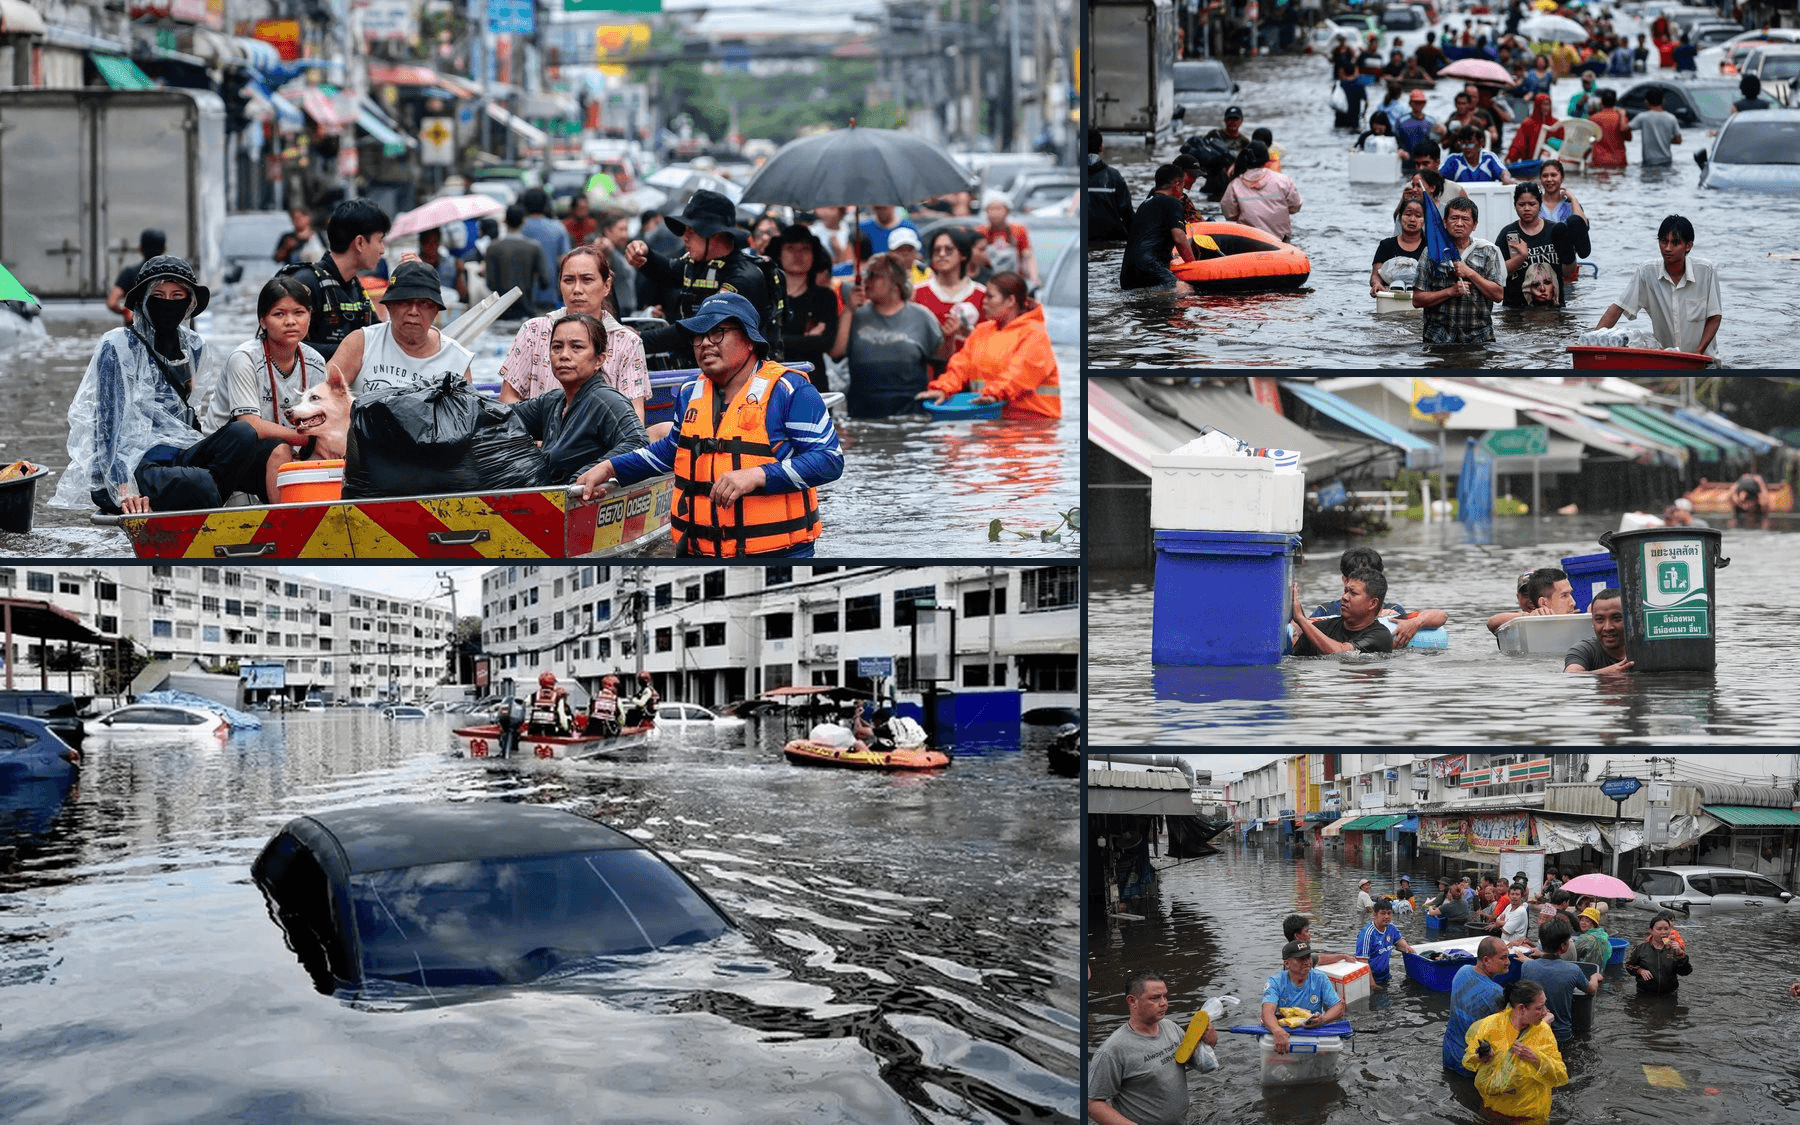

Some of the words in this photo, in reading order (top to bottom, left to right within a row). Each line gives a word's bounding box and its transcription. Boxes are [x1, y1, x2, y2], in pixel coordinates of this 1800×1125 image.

[373, 364, 407, 378] UNITED
[1651, 544, 1700, 559] ขยะมูลสัตว์
[1625, 780, 1635, 789] 35
